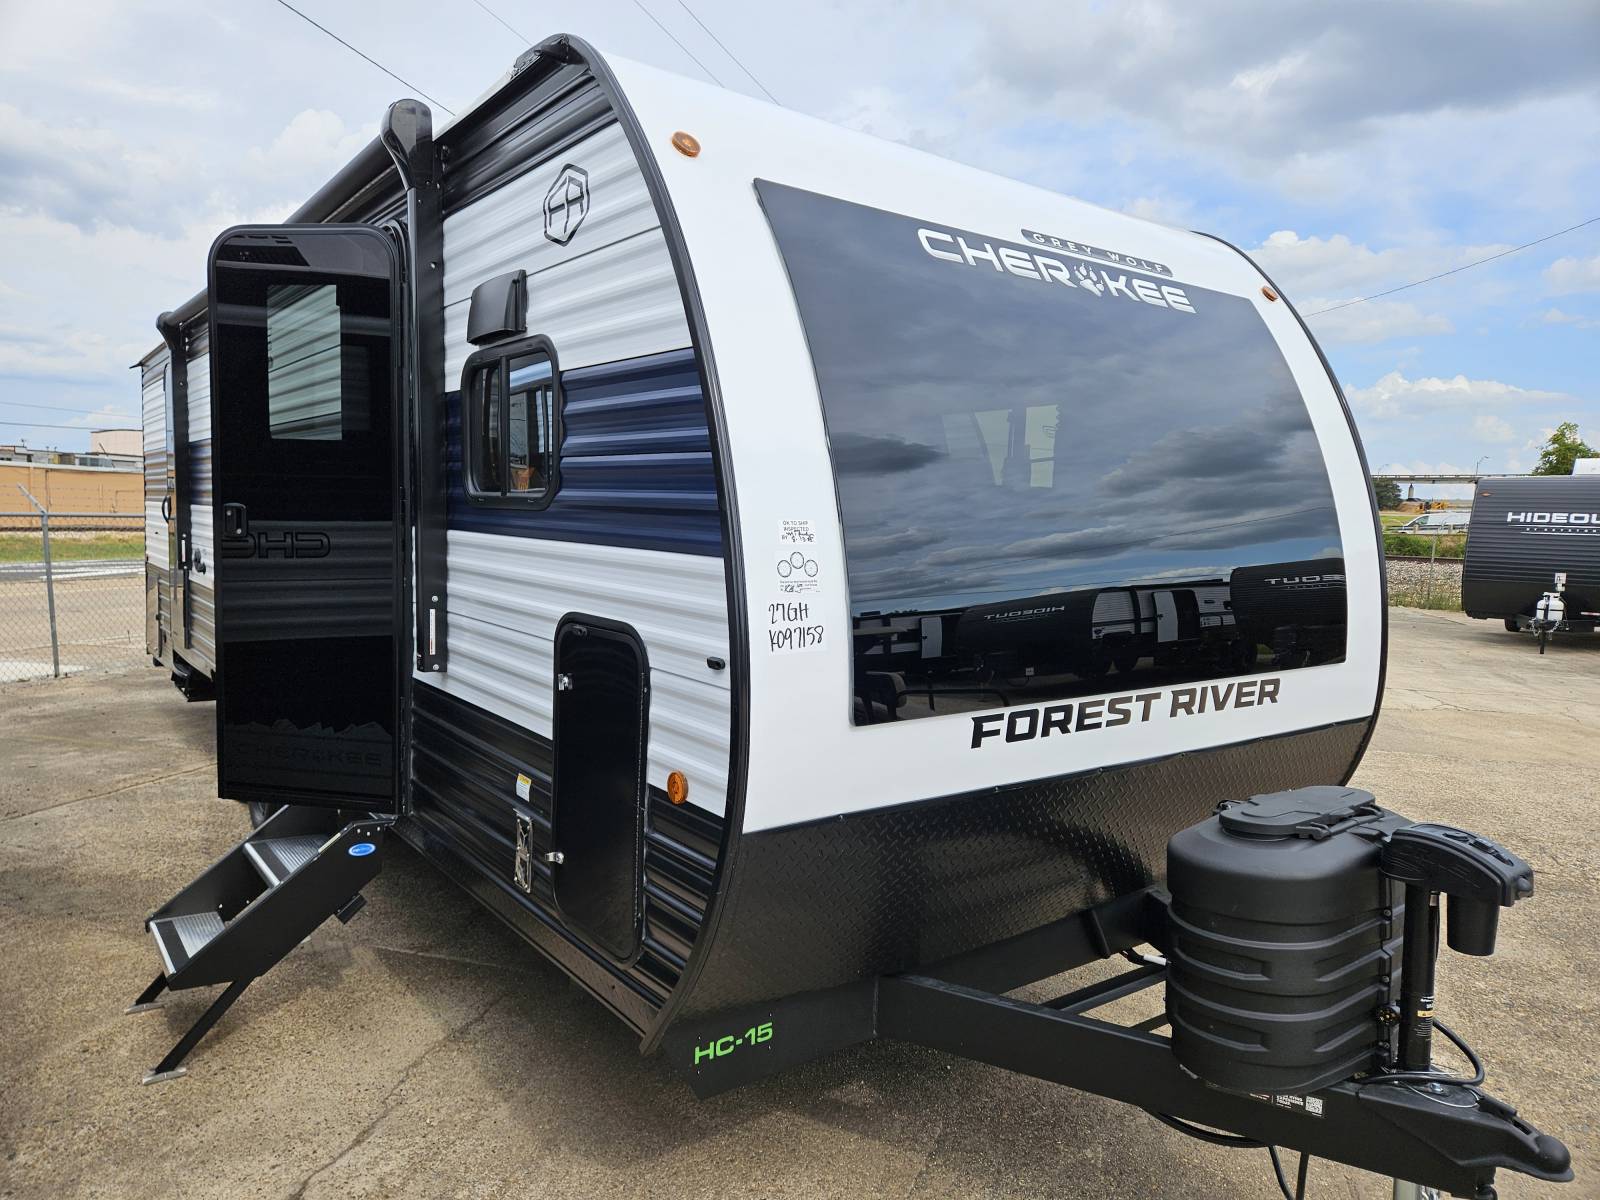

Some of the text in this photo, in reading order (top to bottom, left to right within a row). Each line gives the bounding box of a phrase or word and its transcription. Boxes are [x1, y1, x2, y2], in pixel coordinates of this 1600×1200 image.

[1032, 232, 1164, 274] GREY WOLF
[768, 602, 809, 625] 27GH
[970, 678, 1282, 750] FOREST RIVER
[694, 1022, 773, 1065] HC-15
